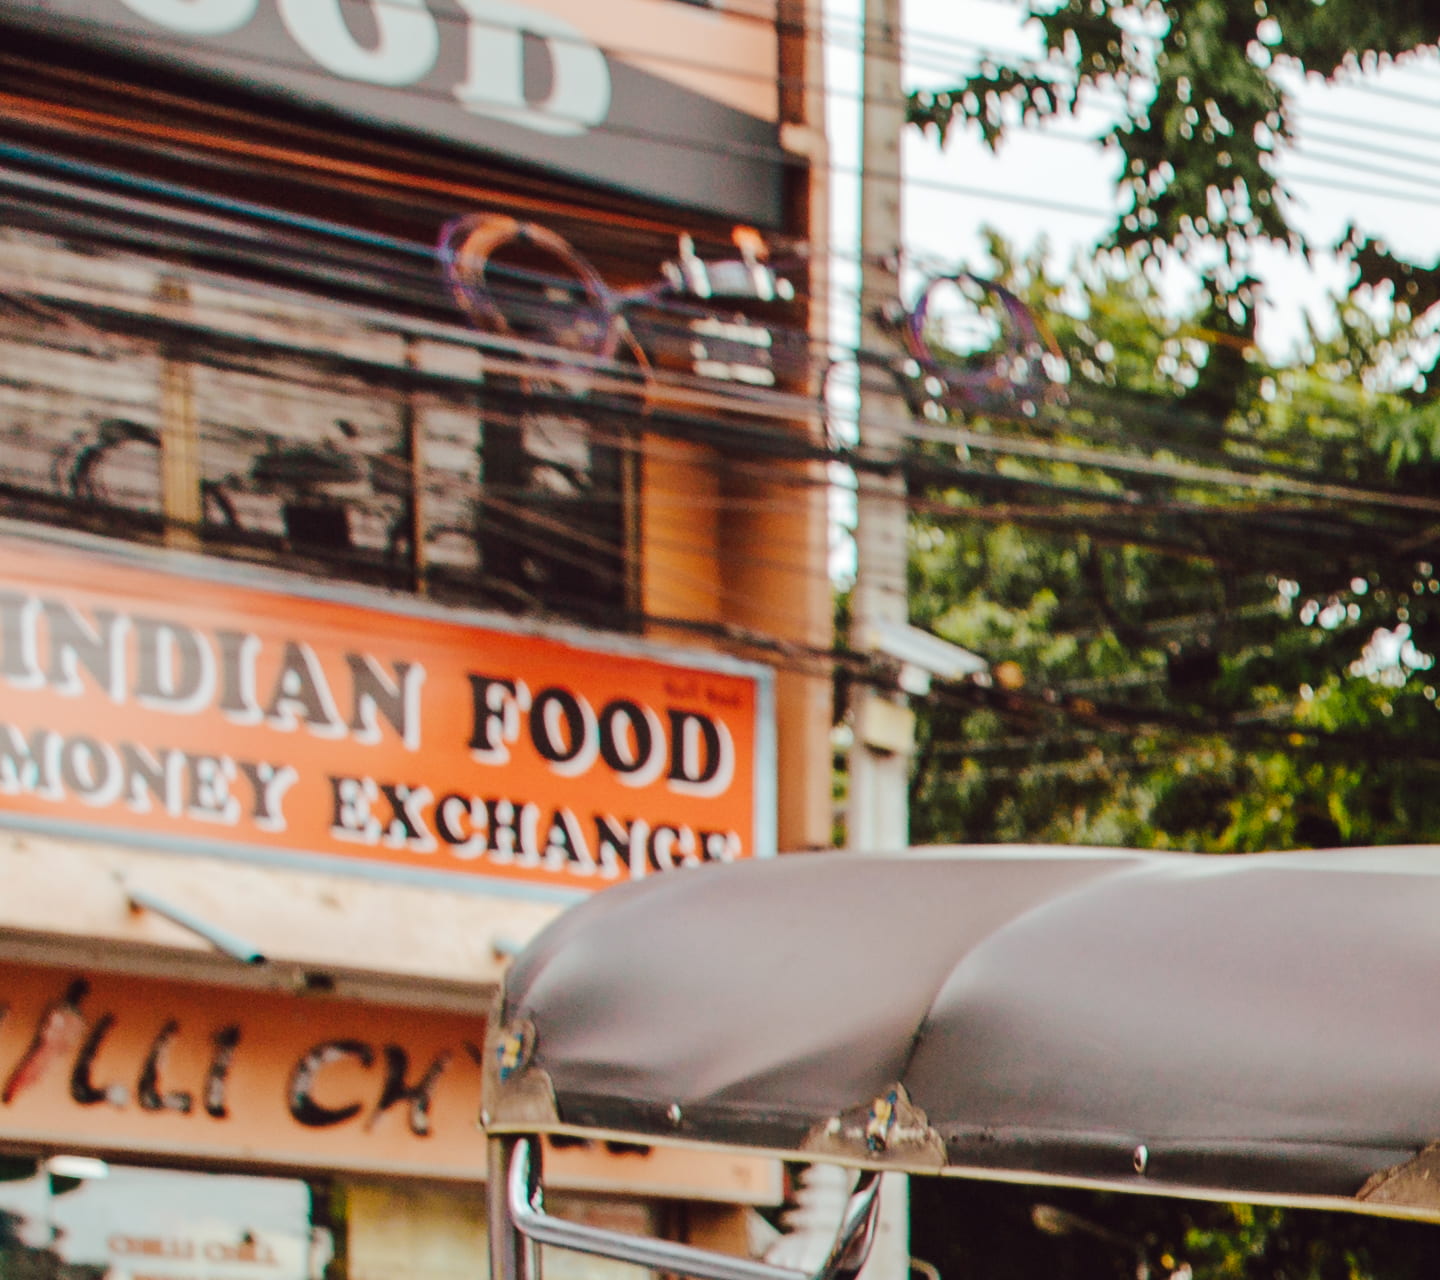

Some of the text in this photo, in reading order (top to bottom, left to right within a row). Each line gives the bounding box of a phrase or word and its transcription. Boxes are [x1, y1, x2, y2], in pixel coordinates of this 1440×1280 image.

[0, 592, 735, 799] INDIAN FOOD
[0, 723, 299, 833] MONEY
